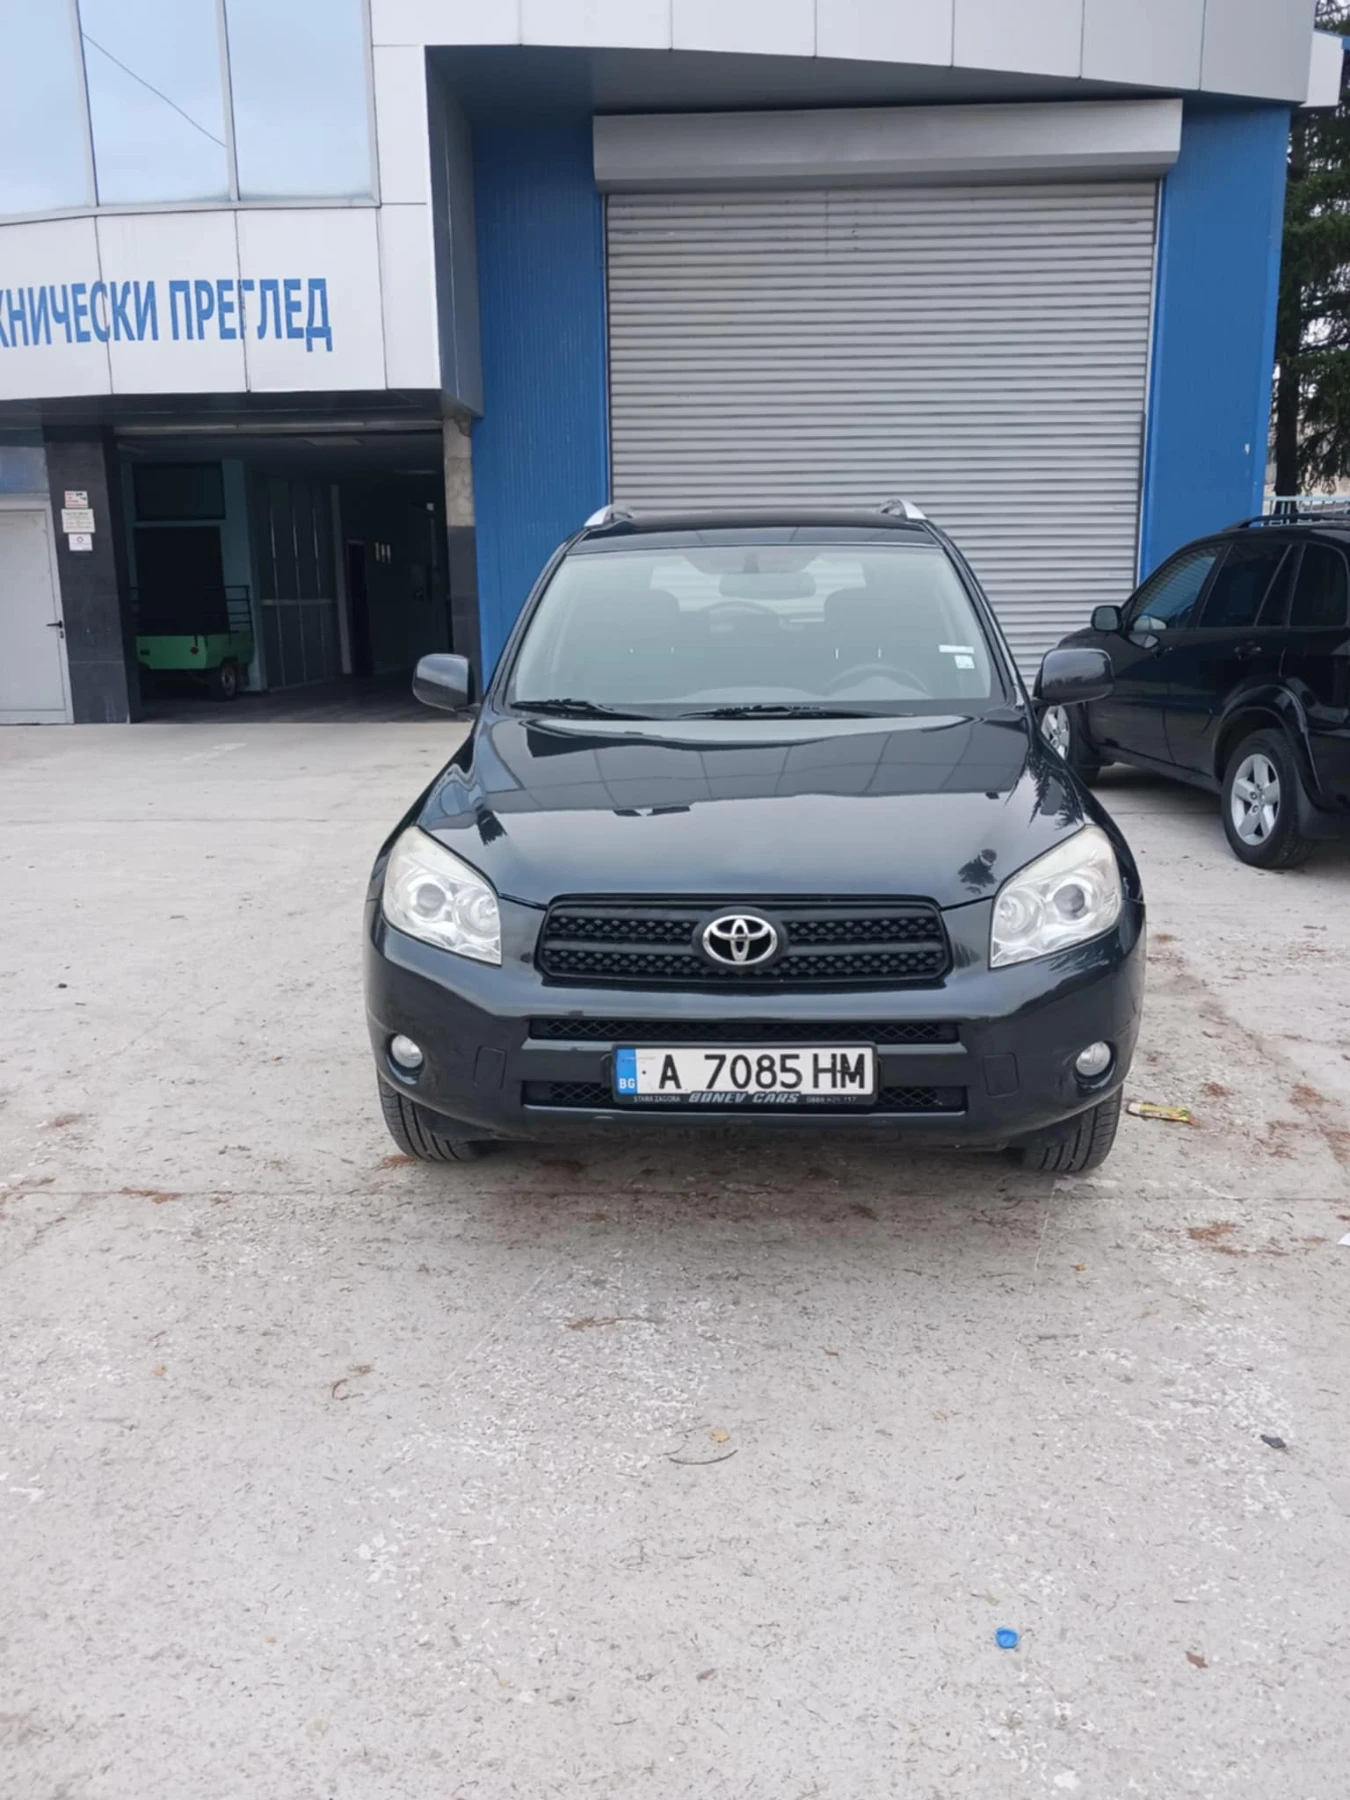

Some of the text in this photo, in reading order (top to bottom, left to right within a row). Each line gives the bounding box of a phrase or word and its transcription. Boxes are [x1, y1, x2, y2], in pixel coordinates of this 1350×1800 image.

[169, 278, 333, 352] ПРЕГЛЕД
[618, 1077, 636, 1090] BG
[658, 1053, 866, 1090] A 7085 HM
[752, 1092, 799, 1103] CARS
